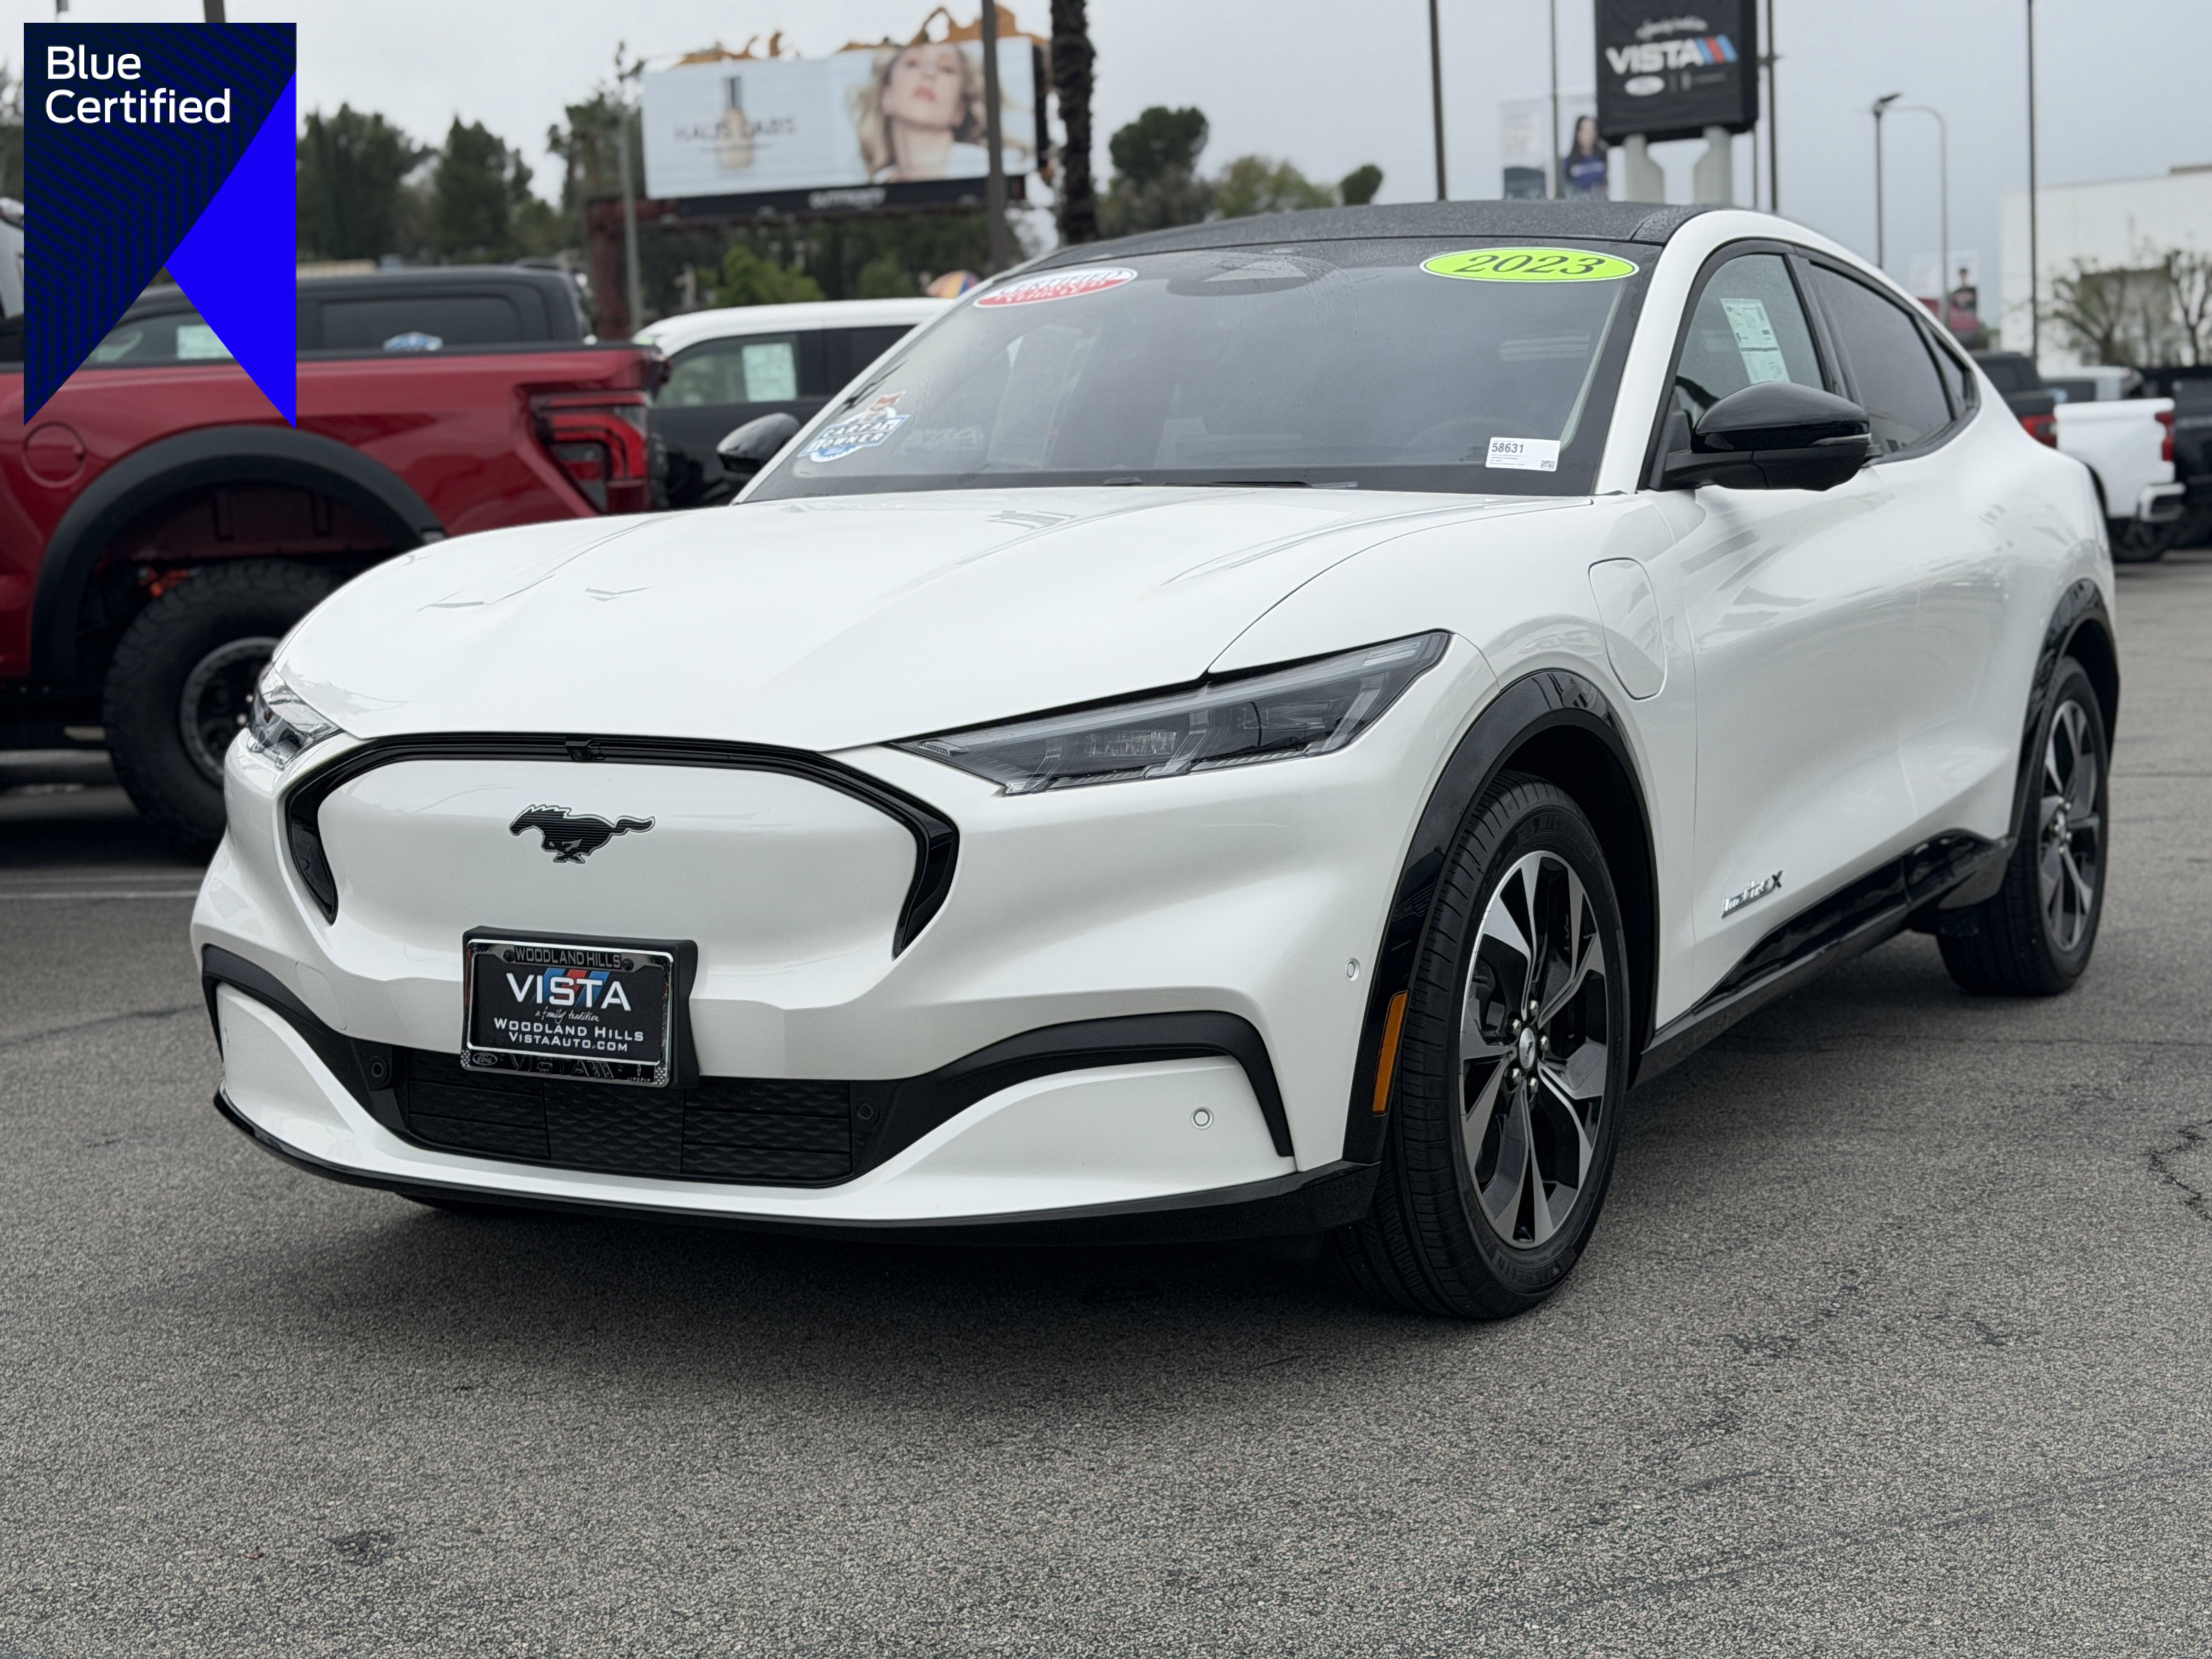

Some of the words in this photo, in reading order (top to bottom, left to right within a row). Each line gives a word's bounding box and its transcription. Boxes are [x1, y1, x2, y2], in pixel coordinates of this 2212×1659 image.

[1605, 38, 1705, 75] VISTA
[1453, 255, 1606, 274] 2023
[823, 422, 895, 438] CARFAX
[1492, 443, 1524, 453] 58631
[515, 947, 585, 964] WOODLAND
[586, 952, 621, 968] HILLS
[506, 973, 631, 1011] VISTA
[541, 1006, 567, 1024] family
[568, 1010, 600, 1023] tradition
